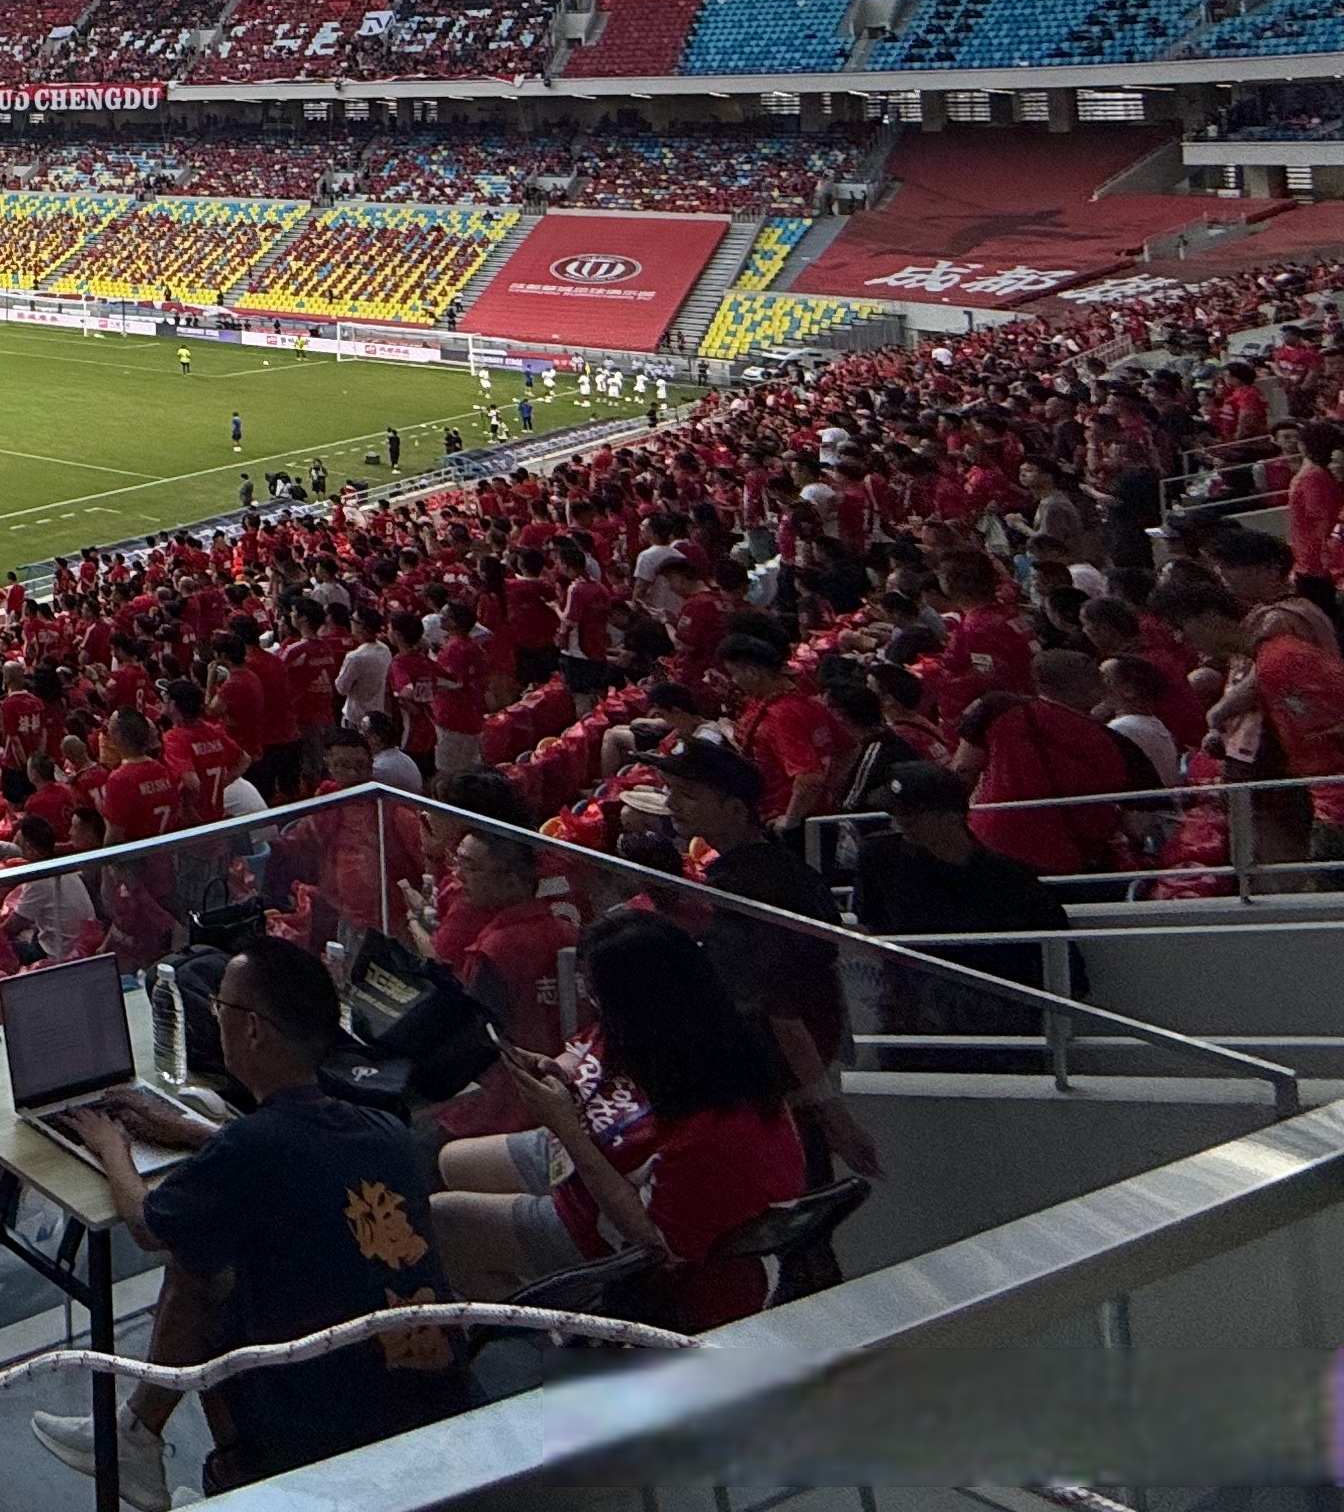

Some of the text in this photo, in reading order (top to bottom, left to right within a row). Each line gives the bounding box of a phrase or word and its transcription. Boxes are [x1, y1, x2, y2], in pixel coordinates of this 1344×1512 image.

[34, 88, 160, 111] CHENGDU
[864, 260, 1077, 295] 成都
[206, 766, 222, 806] 7
[153, 804, 171, 834] 7
